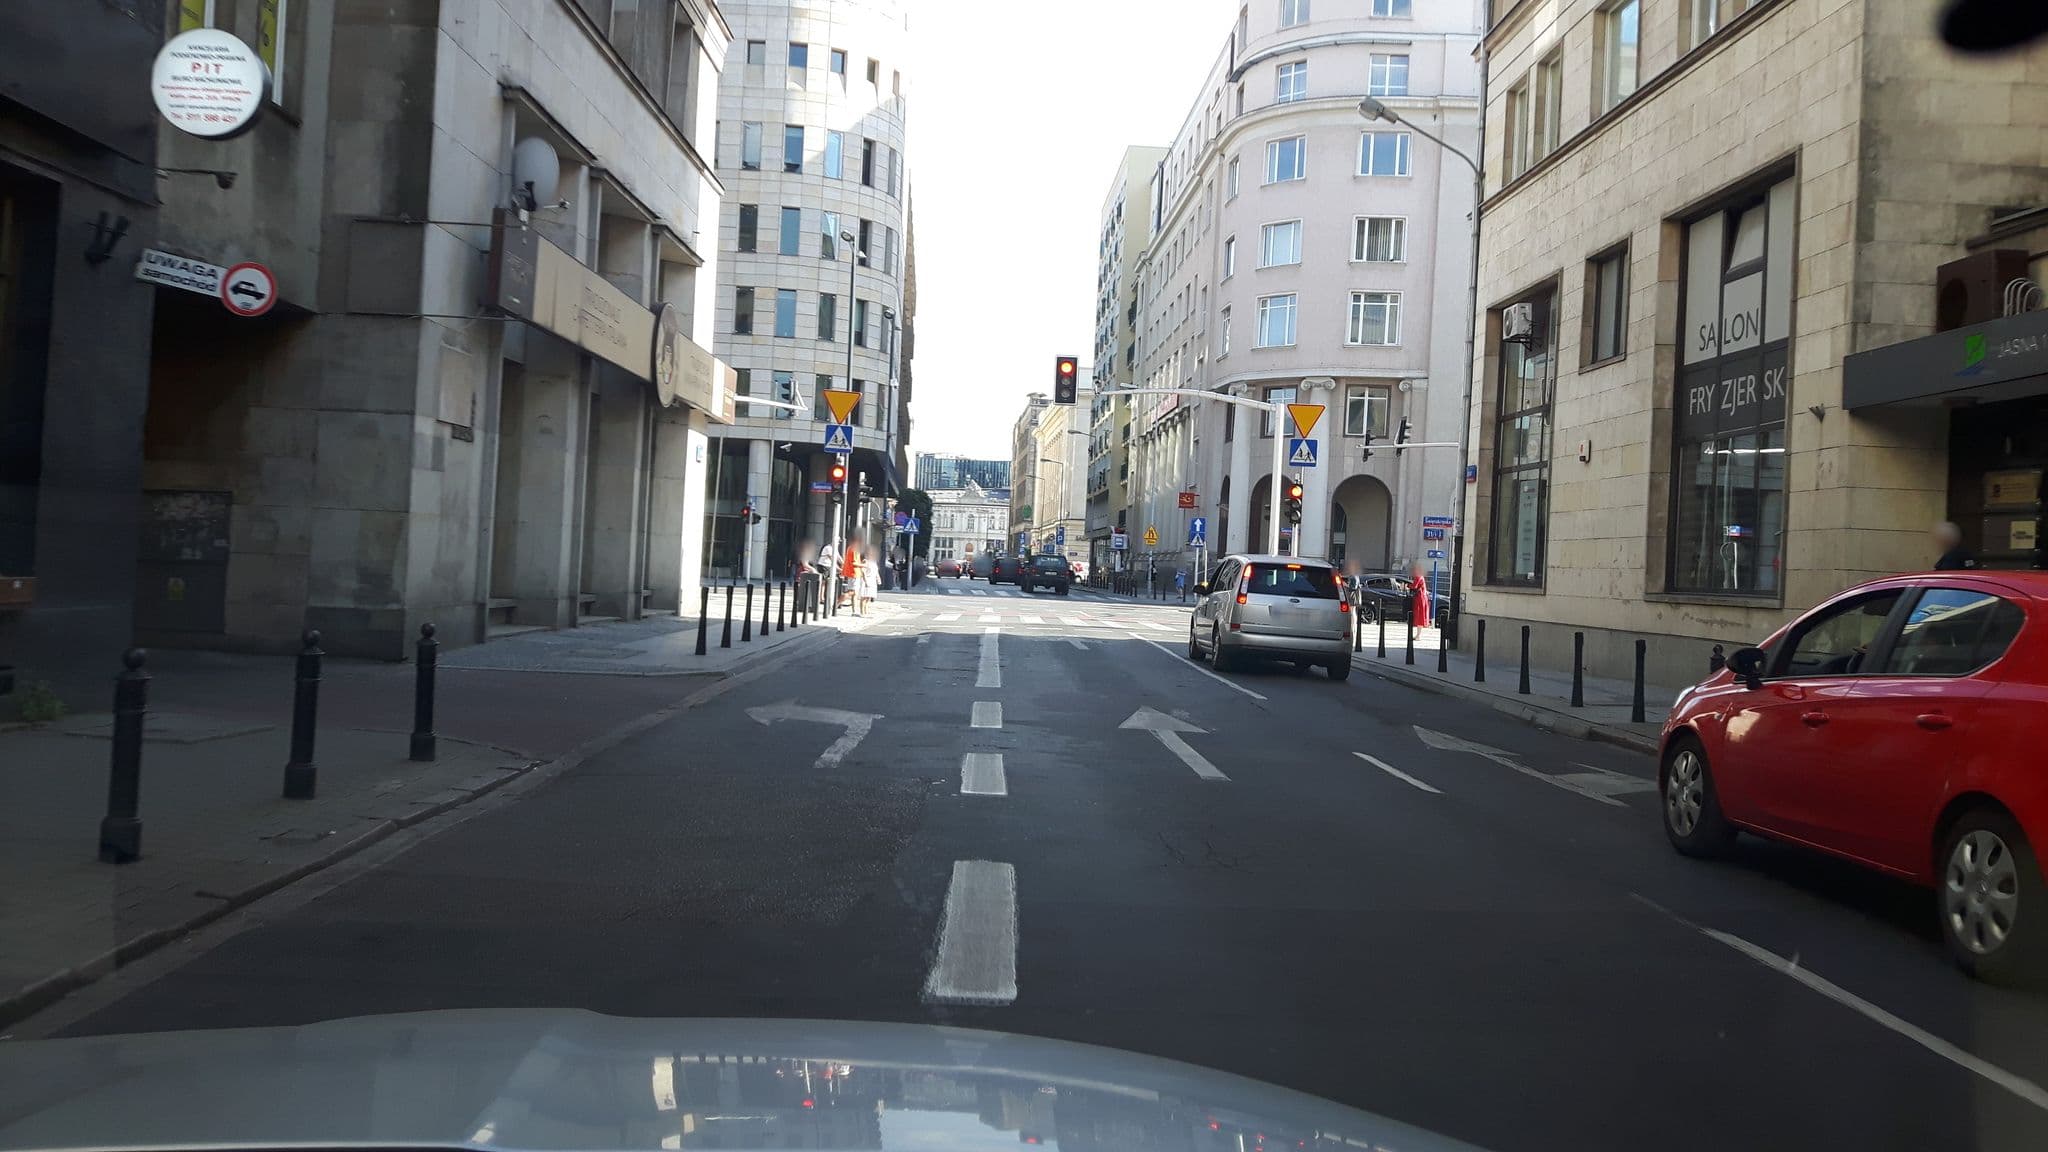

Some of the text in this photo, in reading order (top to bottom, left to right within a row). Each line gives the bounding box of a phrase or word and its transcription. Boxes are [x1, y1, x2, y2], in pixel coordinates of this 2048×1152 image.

[191, 62, 224, 74] PIT
[146, 253, 218, 279] UWAGA
[1699, 308, 1759, 351] SALON
